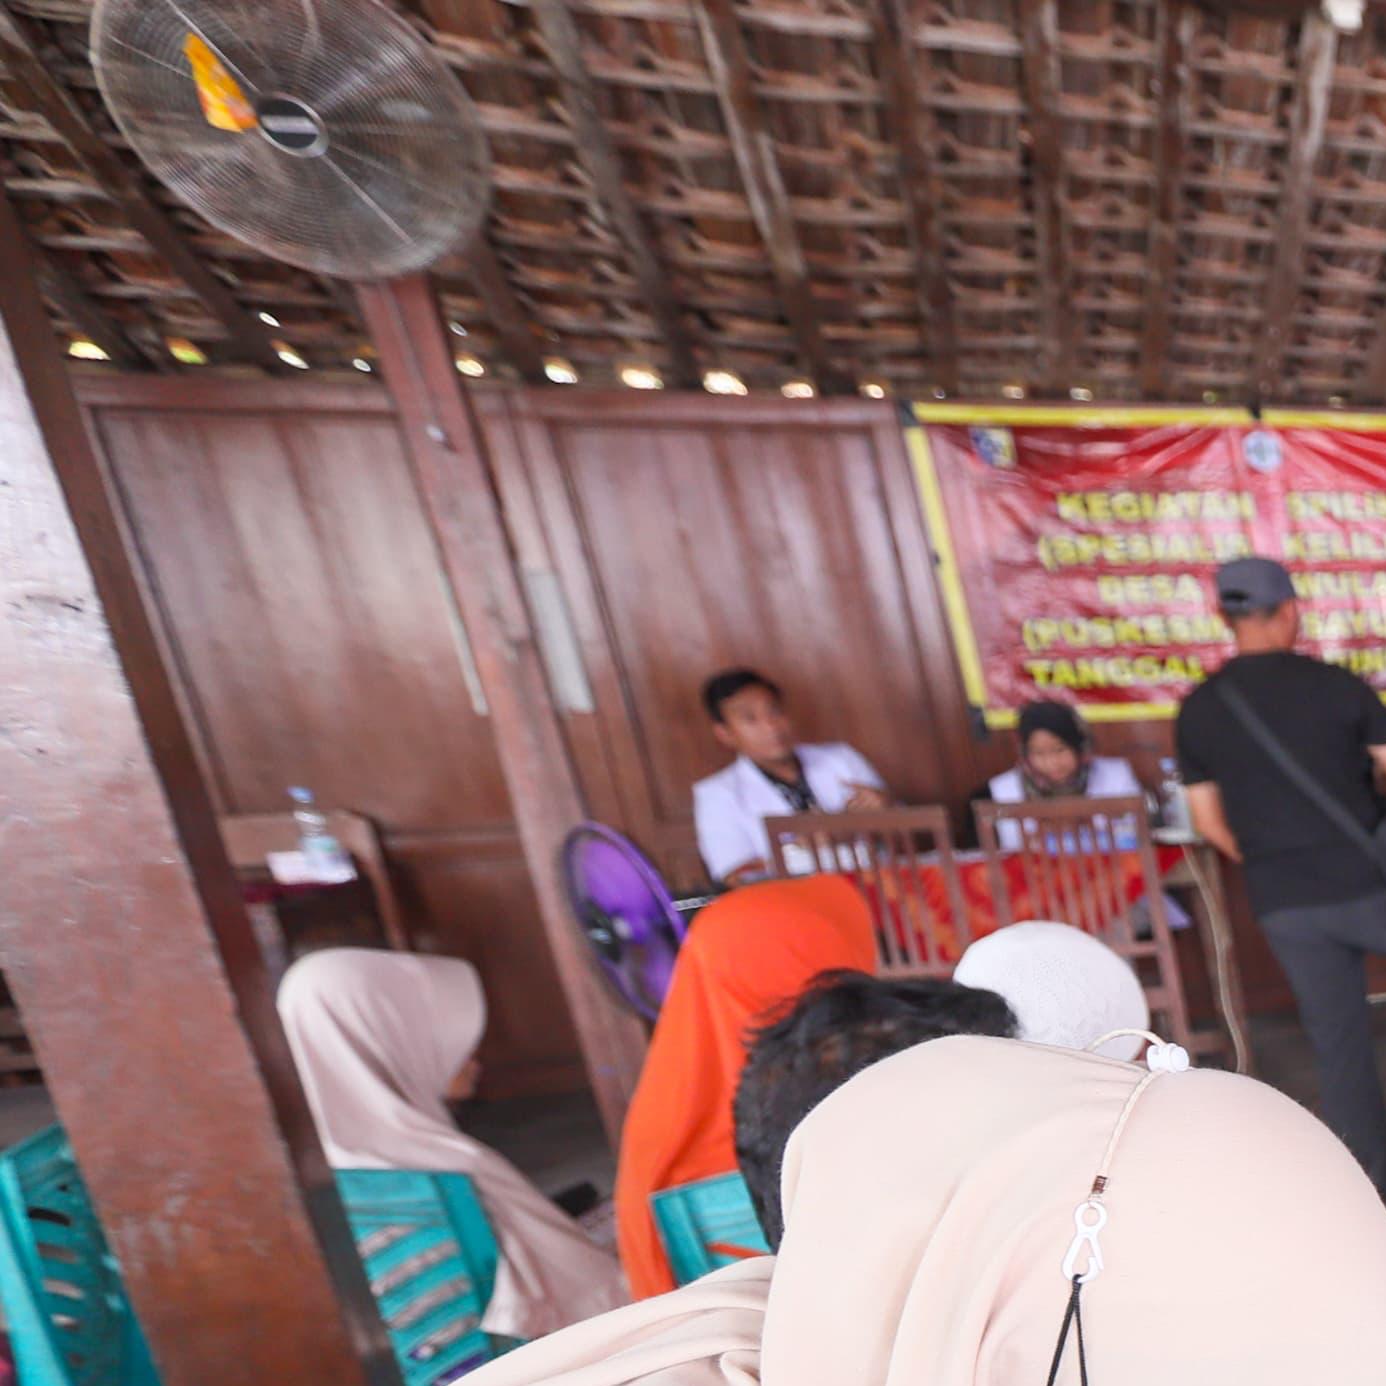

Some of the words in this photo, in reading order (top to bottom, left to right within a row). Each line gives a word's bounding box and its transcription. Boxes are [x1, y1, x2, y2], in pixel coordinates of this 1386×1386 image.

[1056, 491, 1254, 523] KEGIATAN
[1098, 574, 1204, 604] DESA
[1023, 655, 1207, 689] TANGGAL
